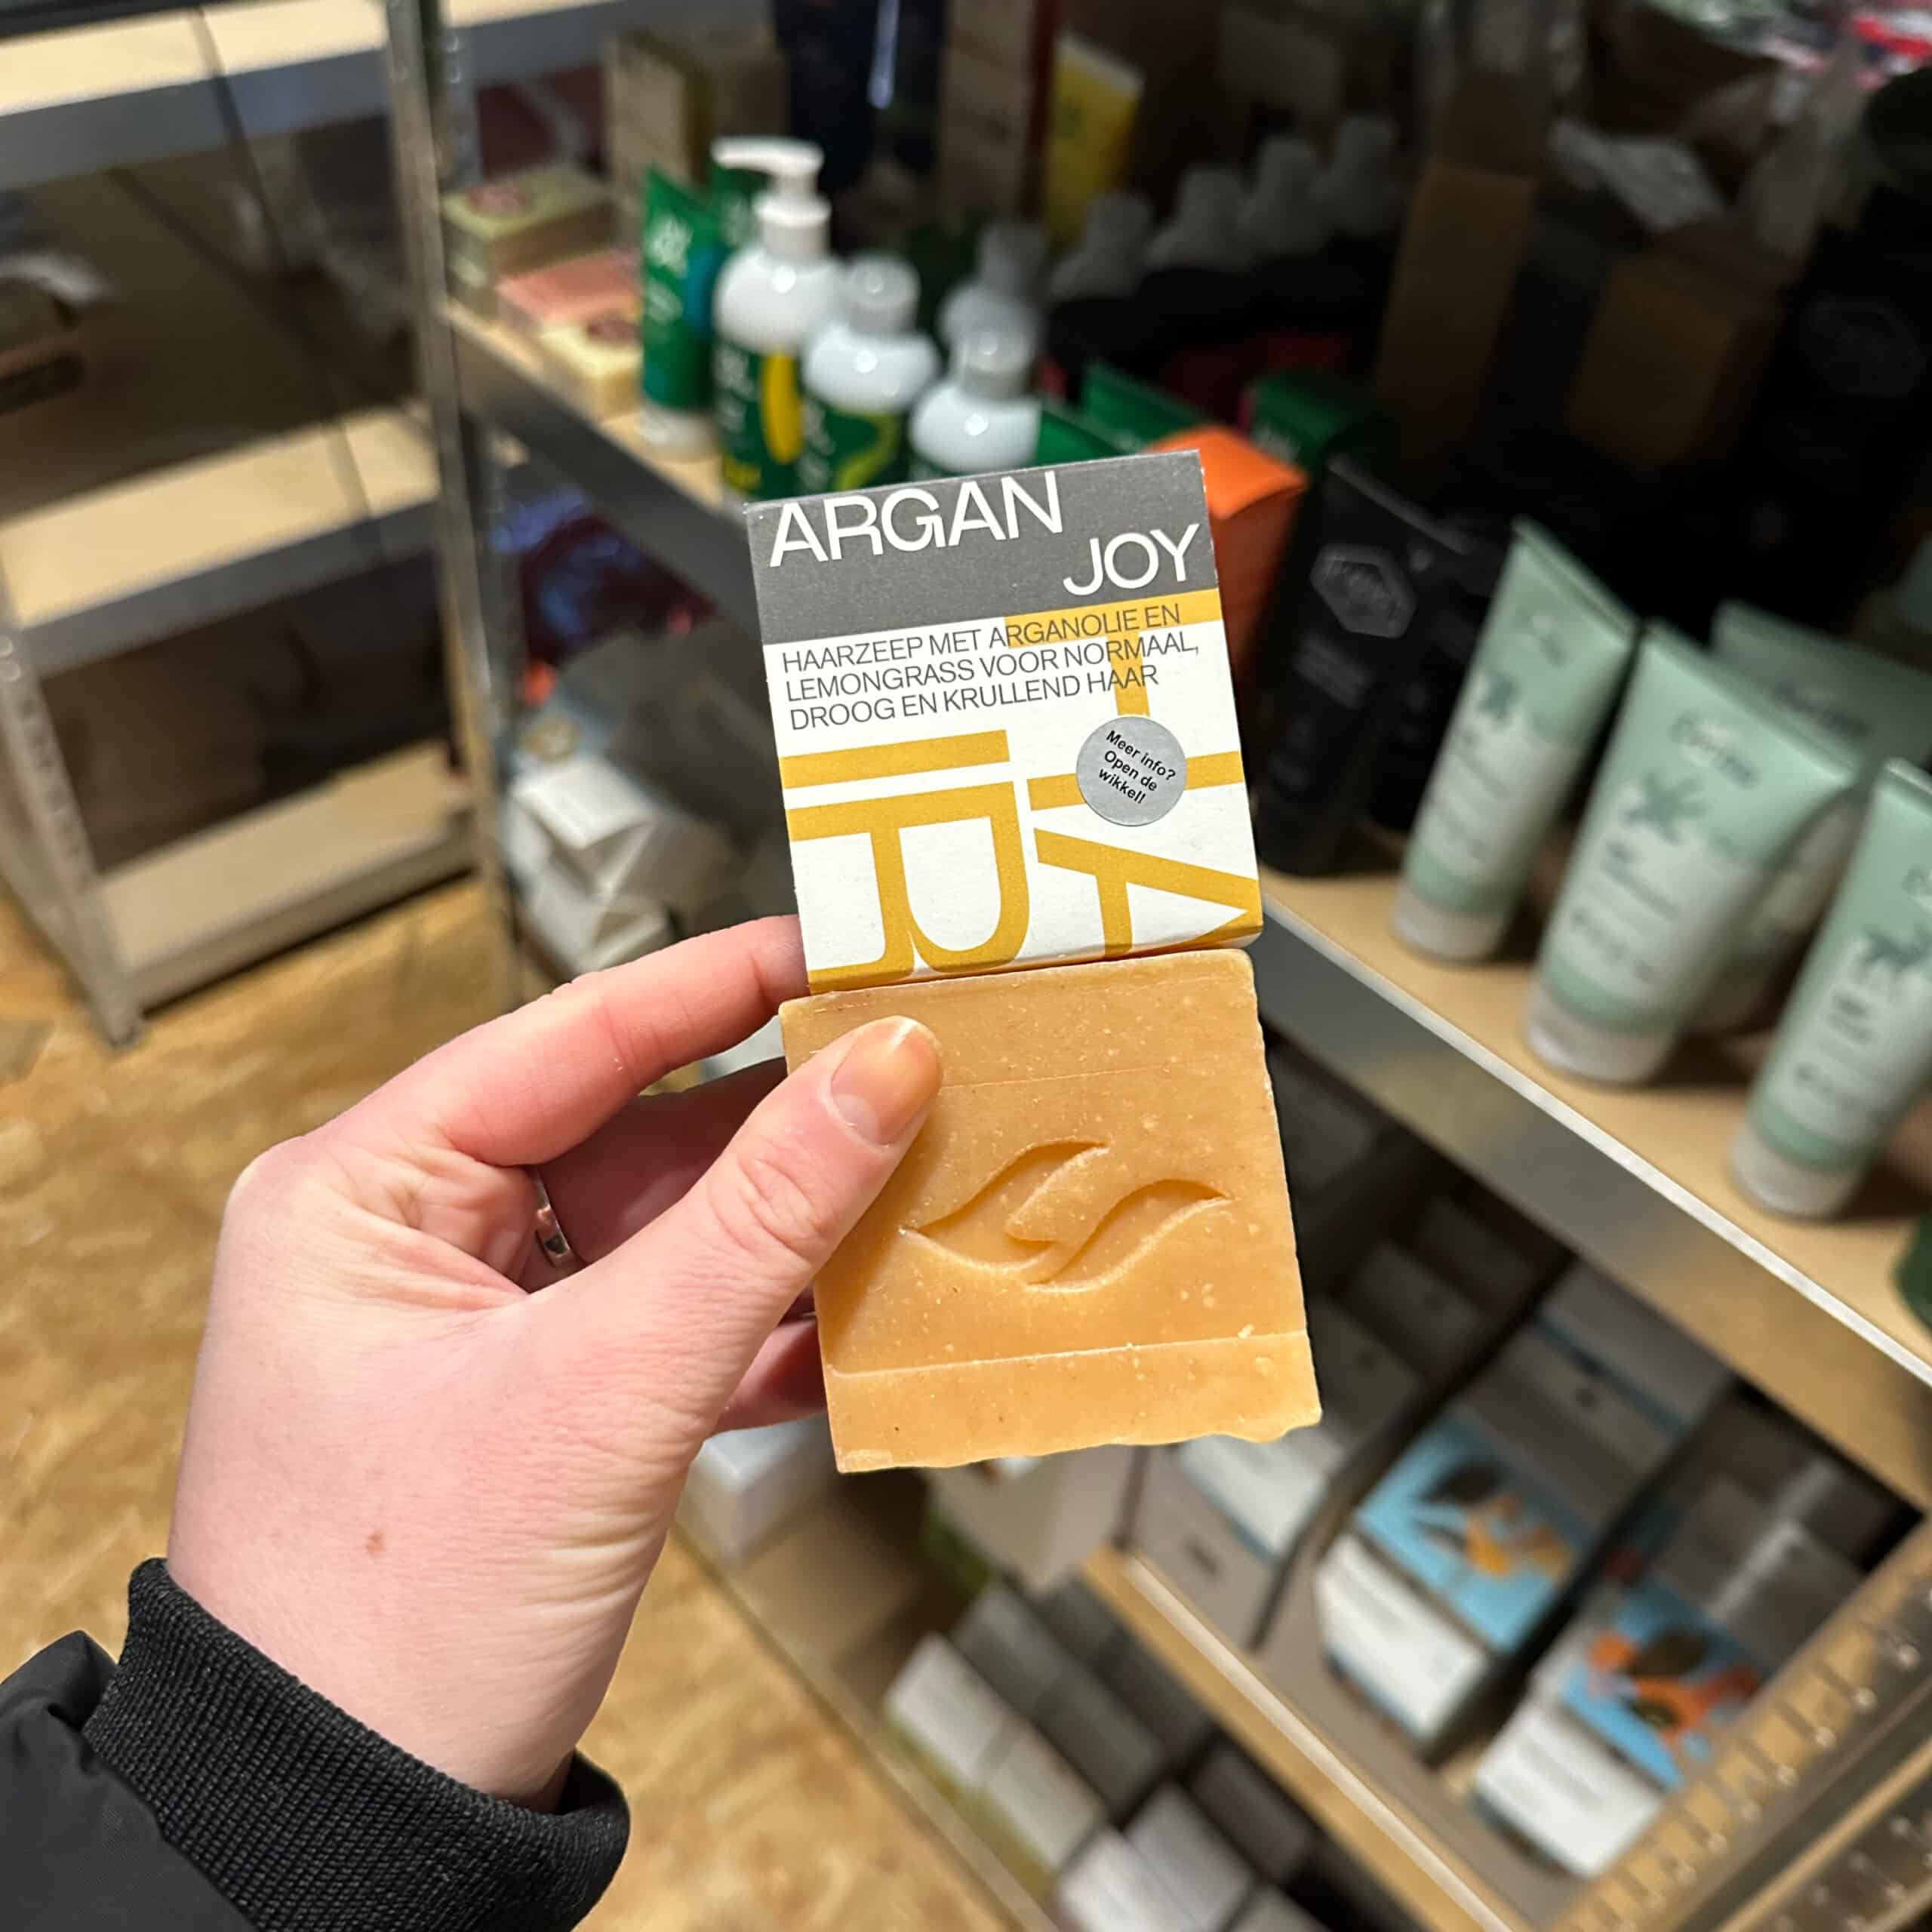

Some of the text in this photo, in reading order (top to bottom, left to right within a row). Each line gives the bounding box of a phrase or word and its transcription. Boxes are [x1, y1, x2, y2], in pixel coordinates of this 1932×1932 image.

[769, 470, 1063, 568] ARGAN
[1063, 524, 1200, 596] JOY
[783, 603, 1181, 673] HAARZEEP MET ARGANOLIE EN
[786, 631, 1199, 702] LEMONGRASS VOOR NORMAAL,
[790, 664, 1159, 731] DROOG EN KRULLEND HAAR
[1098, 768, 1146, 804] wikkel!
[1104, 750, 1158, 792] Open de
[1106, 730, 1176, 780] Meer info?
